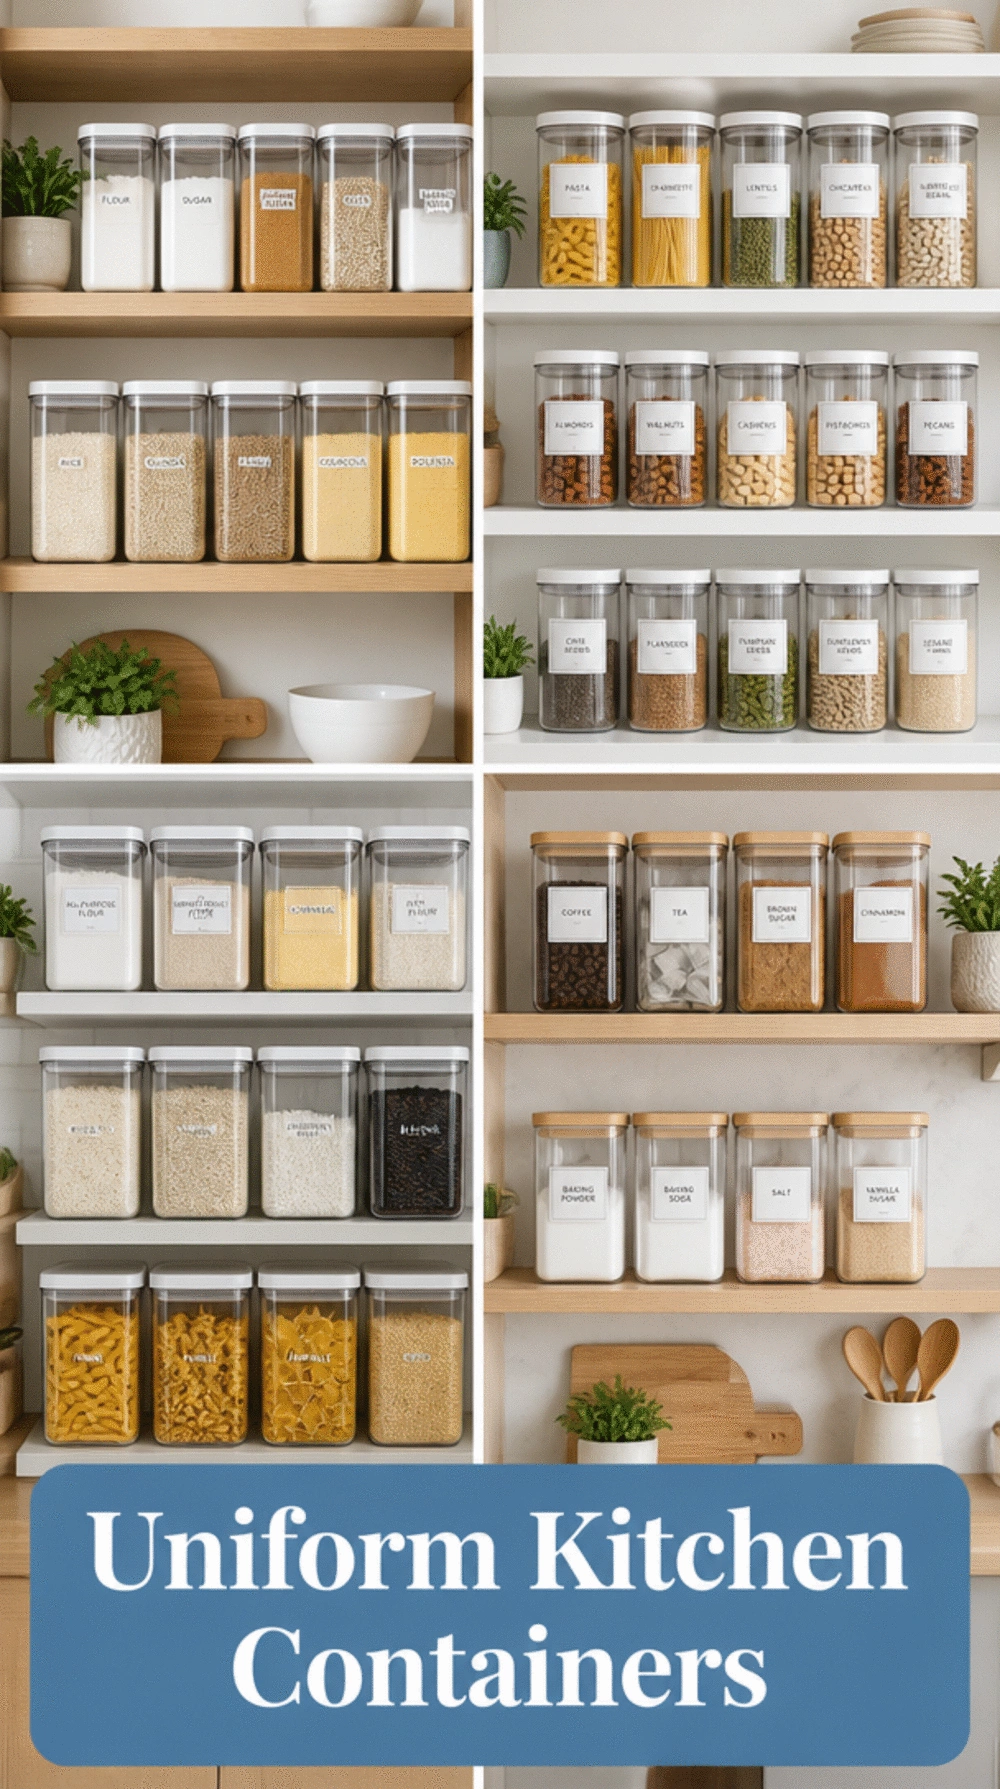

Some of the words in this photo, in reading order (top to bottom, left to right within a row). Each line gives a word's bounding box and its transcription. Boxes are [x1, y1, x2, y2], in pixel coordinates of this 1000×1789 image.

[565, 184, 591, 192] PASTA
[101, 195, 130, 205] FLOUR
[182, 196, 212, 205] SUGAR
[923, 420, 955, 430] PECANS
[561, 908, 592, 917] COFFEE
[672, 908, 688, 917] TEA
[767, 905, 797, 913] BROWN
[769, 914, 796, 923] SUGAR
[562, 1185, 594, 1193] BAKING
[664, 1185, 695, 1193] BAKING
[772, 1188, 791, 1196] SALT
[561, 1194, 596, 1203] POWDER
[669, 1194, 691, 1203] SODA
